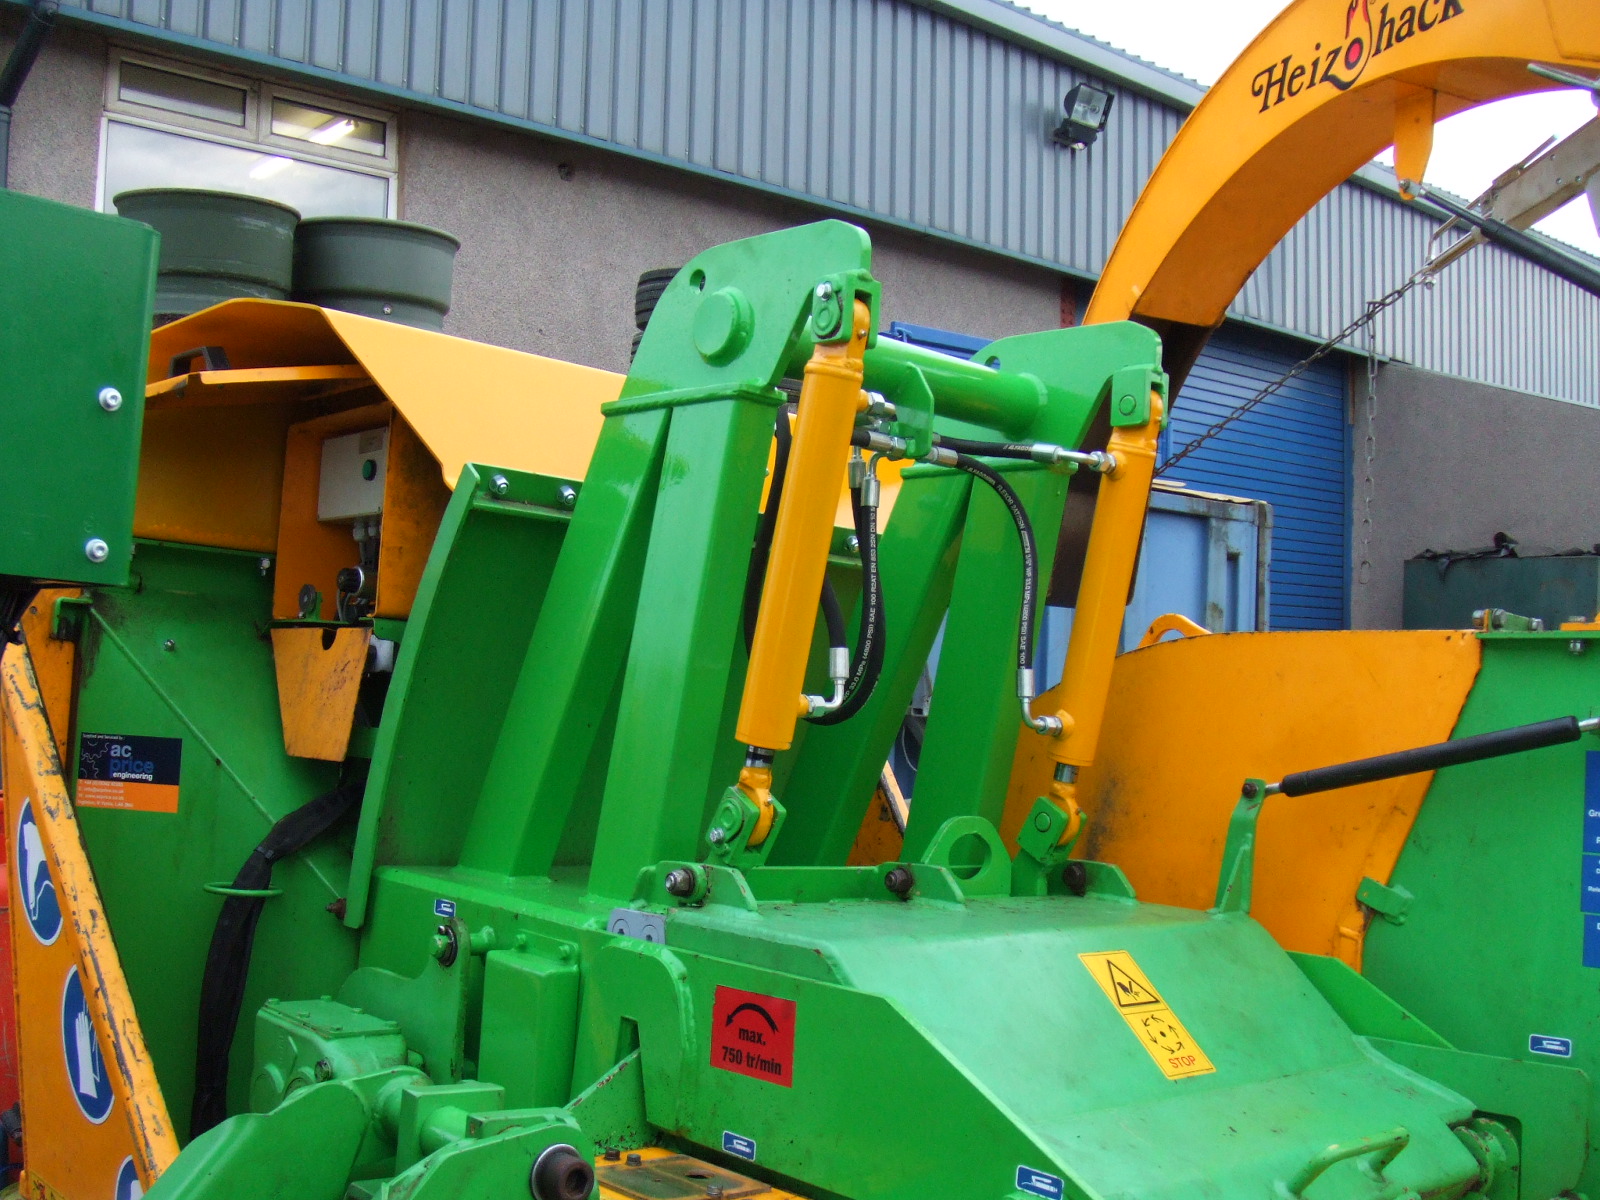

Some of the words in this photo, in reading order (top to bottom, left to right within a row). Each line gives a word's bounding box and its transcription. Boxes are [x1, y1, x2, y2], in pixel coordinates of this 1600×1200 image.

[996, 484, 1014, 505] FLEXOR
[870, 522, 876, 532] DN
[870, 562, 877, 573] EN
[857, 660, 867, 676] MPa
[849, 676, 860, 691] 33.0
[110, 744, 132, 758] ac
[110, 757, 155, 778] price
[112, 771, 153, 782] engineering
[738, 1027, 766, 1046] max.
[722, 1045, 743, 1065] 750
[746, 1051, 782, 1076] tr/min
[1168, 1055, 1196, 1068] STOP
